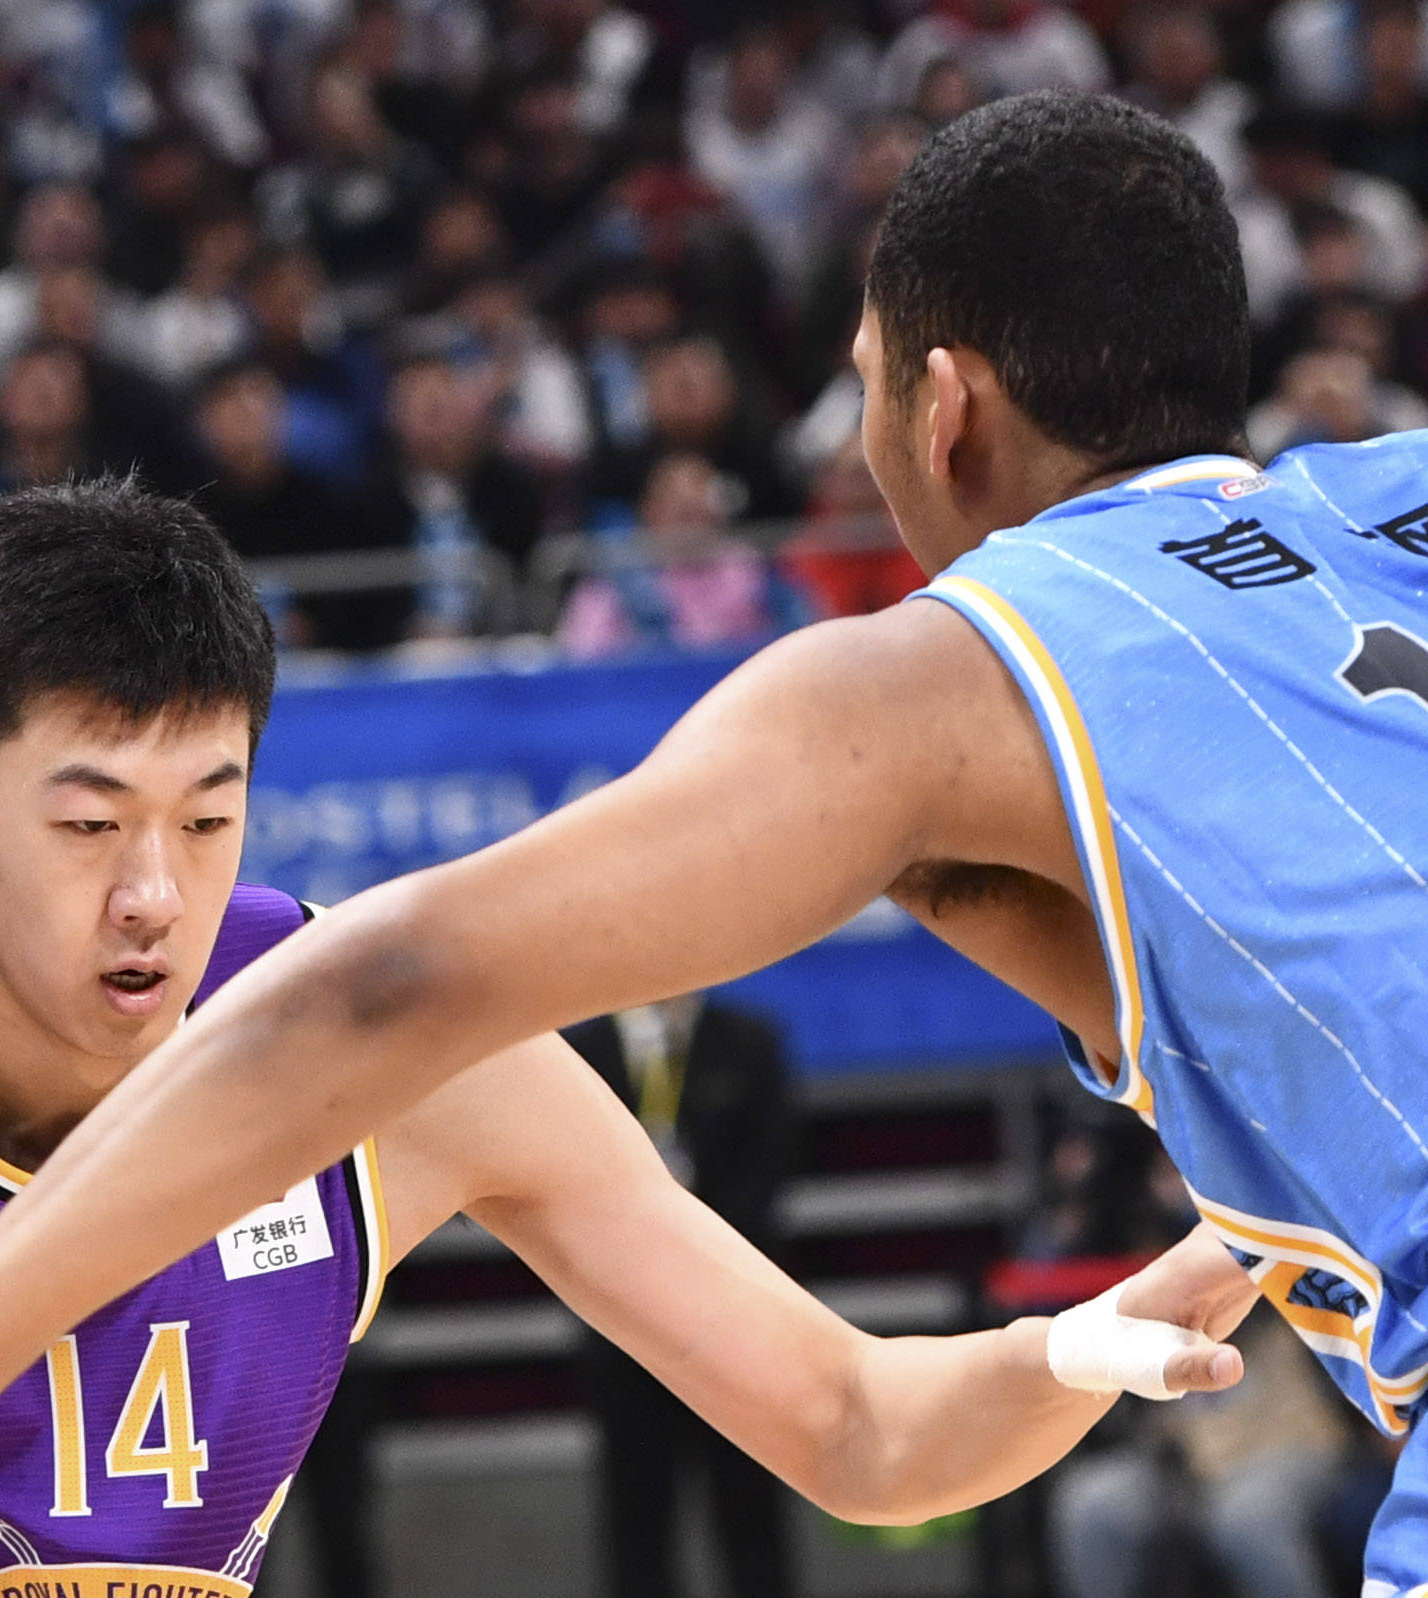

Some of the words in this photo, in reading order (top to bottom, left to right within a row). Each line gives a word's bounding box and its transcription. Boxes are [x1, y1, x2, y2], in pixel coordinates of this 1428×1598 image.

[233, 1215, 307, 1250] 广发银行
[253, 1244, 298, 1270] CGB
[46, 1321, 209, 1517] 14
